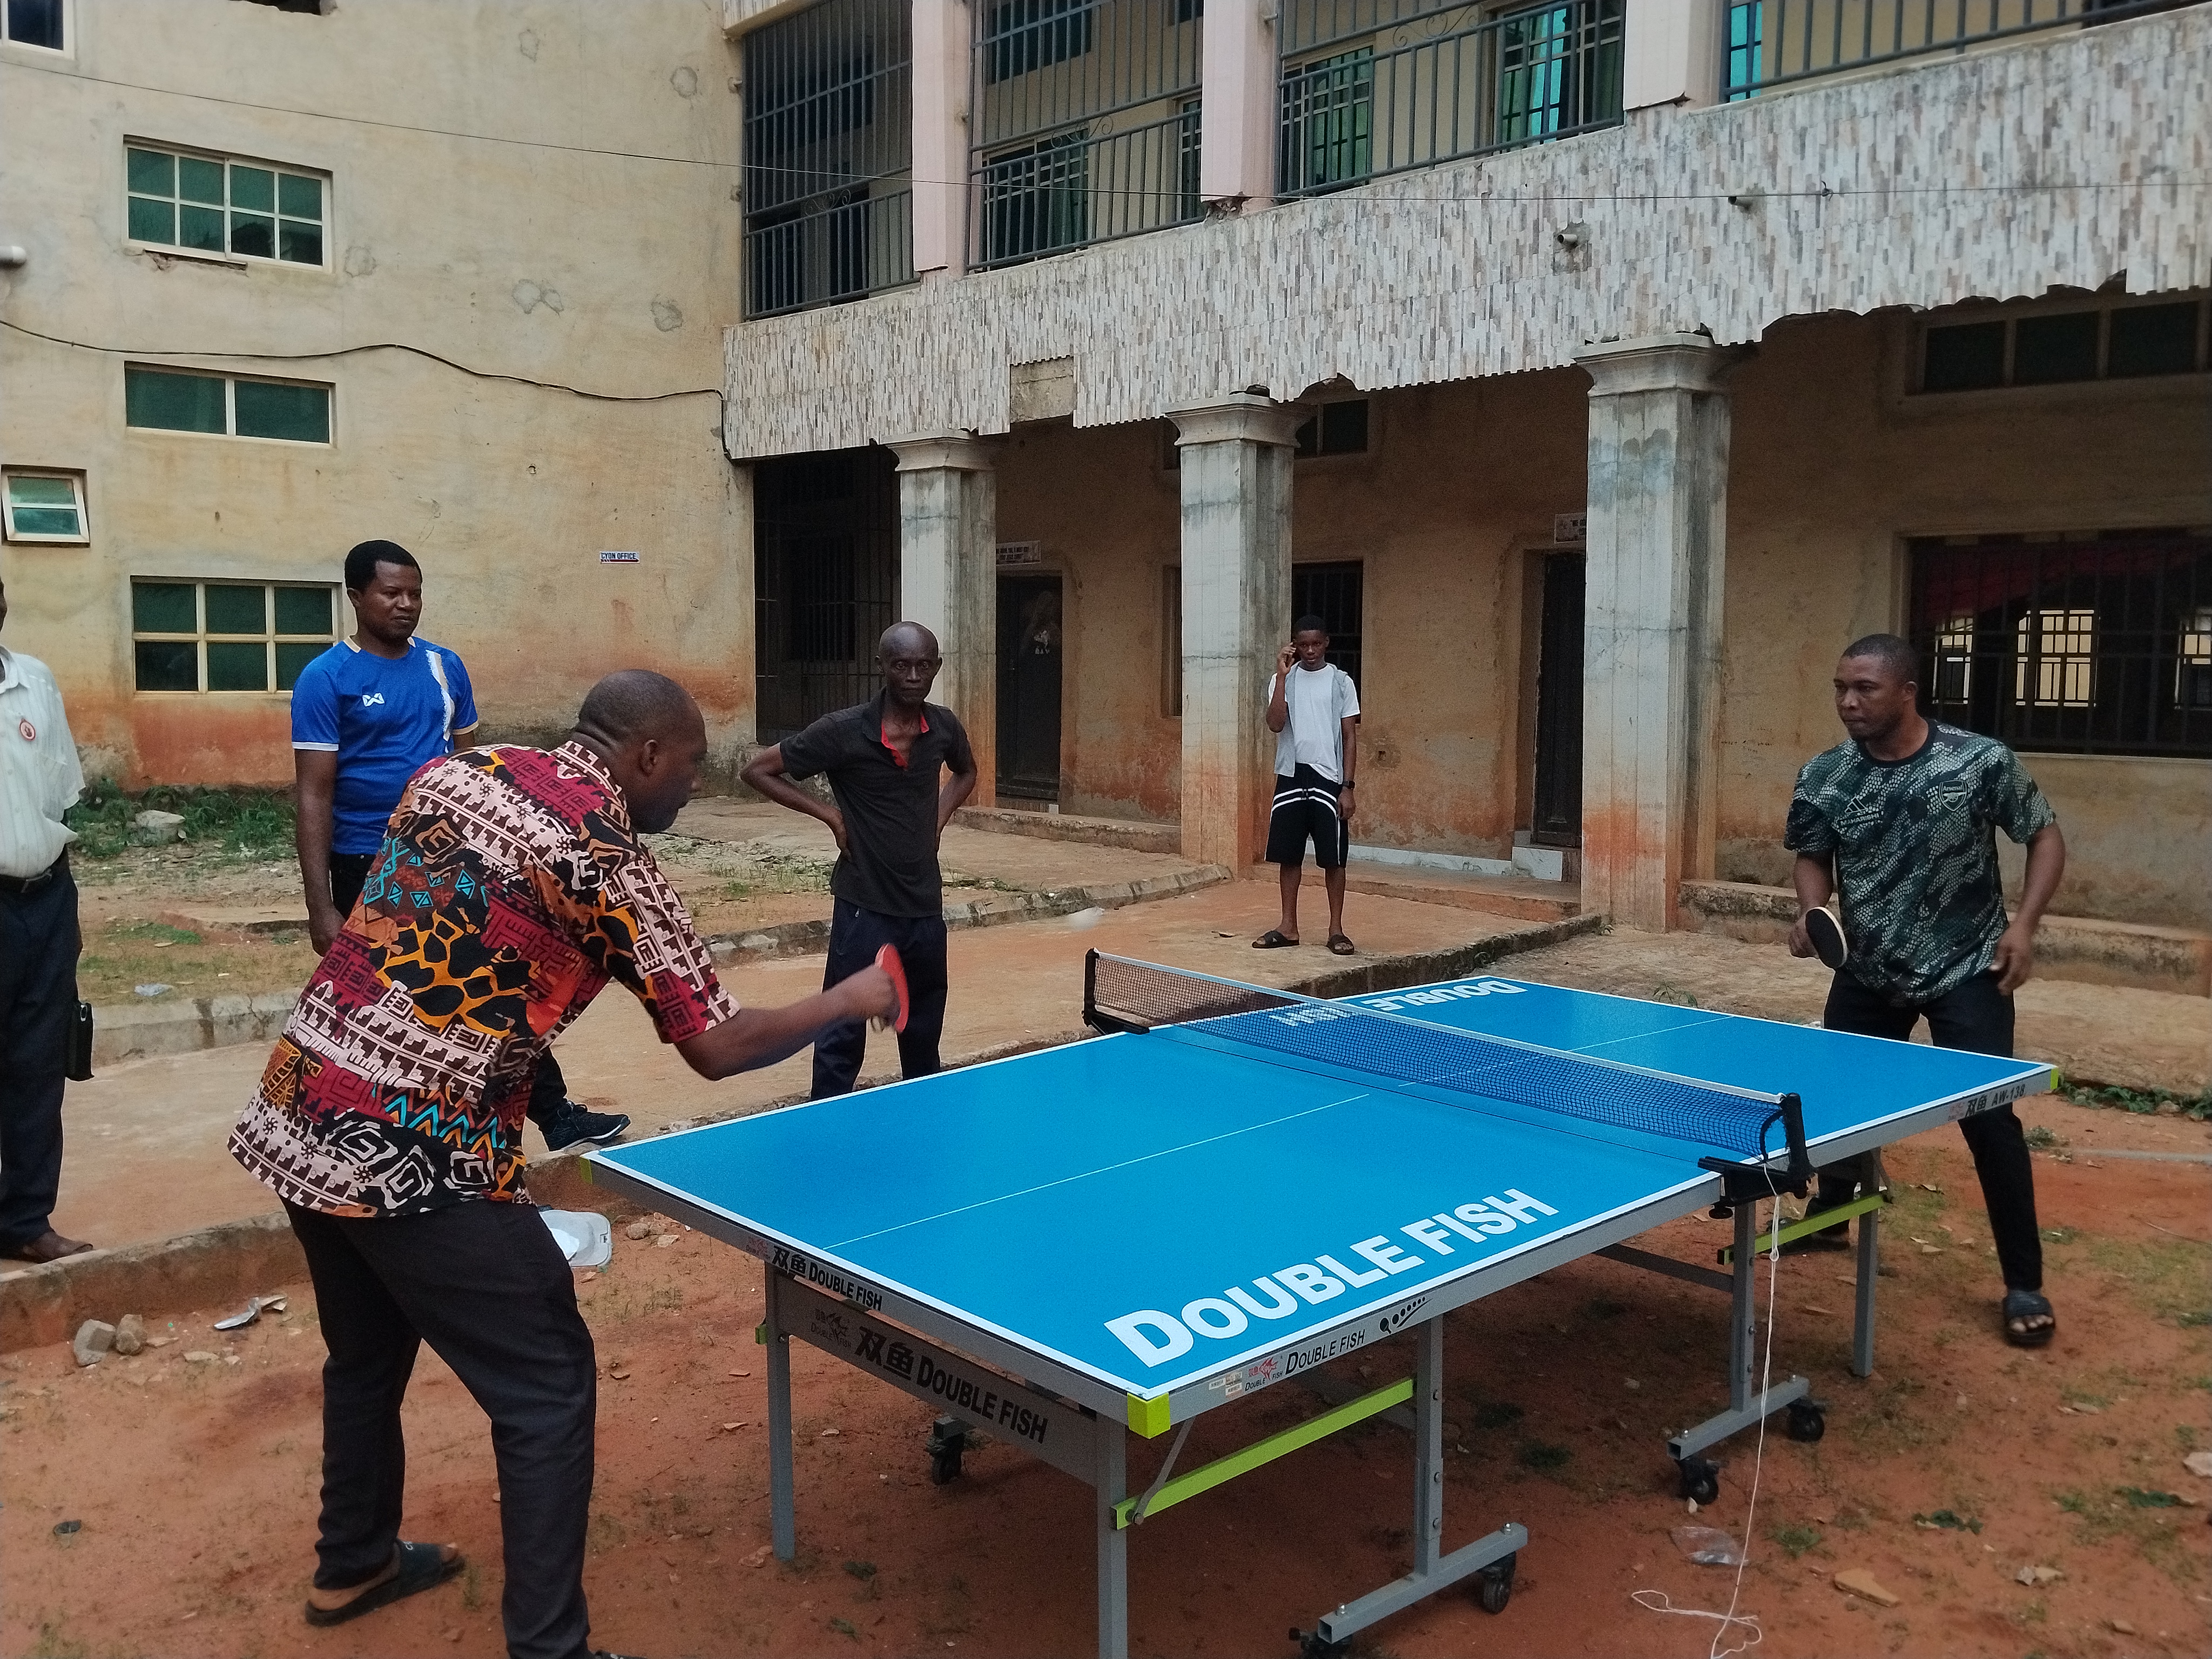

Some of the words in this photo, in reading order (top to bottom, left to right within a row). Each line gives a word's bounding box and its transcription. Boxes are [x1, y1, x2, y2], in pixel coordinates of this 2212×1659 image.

[1840, 813, 1879, 826] MAHARISHI
[1360, 980, 1528, 1011] DOUBLE
[772, 1245, 806, 1276] 双鱼
[808, 1262, 855, 1300] DOUBLE
[855, 1284, 884, 1312] FISH
[1103, 1234, 1426, 1368] DOUBLE
[1399, 1188, 1560, 1256] FISH
[1285, 1339, 1337, 1375] DOUBLE
[1339, 1328, 1366, 1353] FISH
[854, 1325, 915, 1381] 双鱼
[916, 1355, 997, 1419] DOUBLE
[999, 1399, 1049, 1445] FISH
[1245, 1377, 1266, 1392] DOUBLE
[1272, 1371, 1283, 1380] FISH
